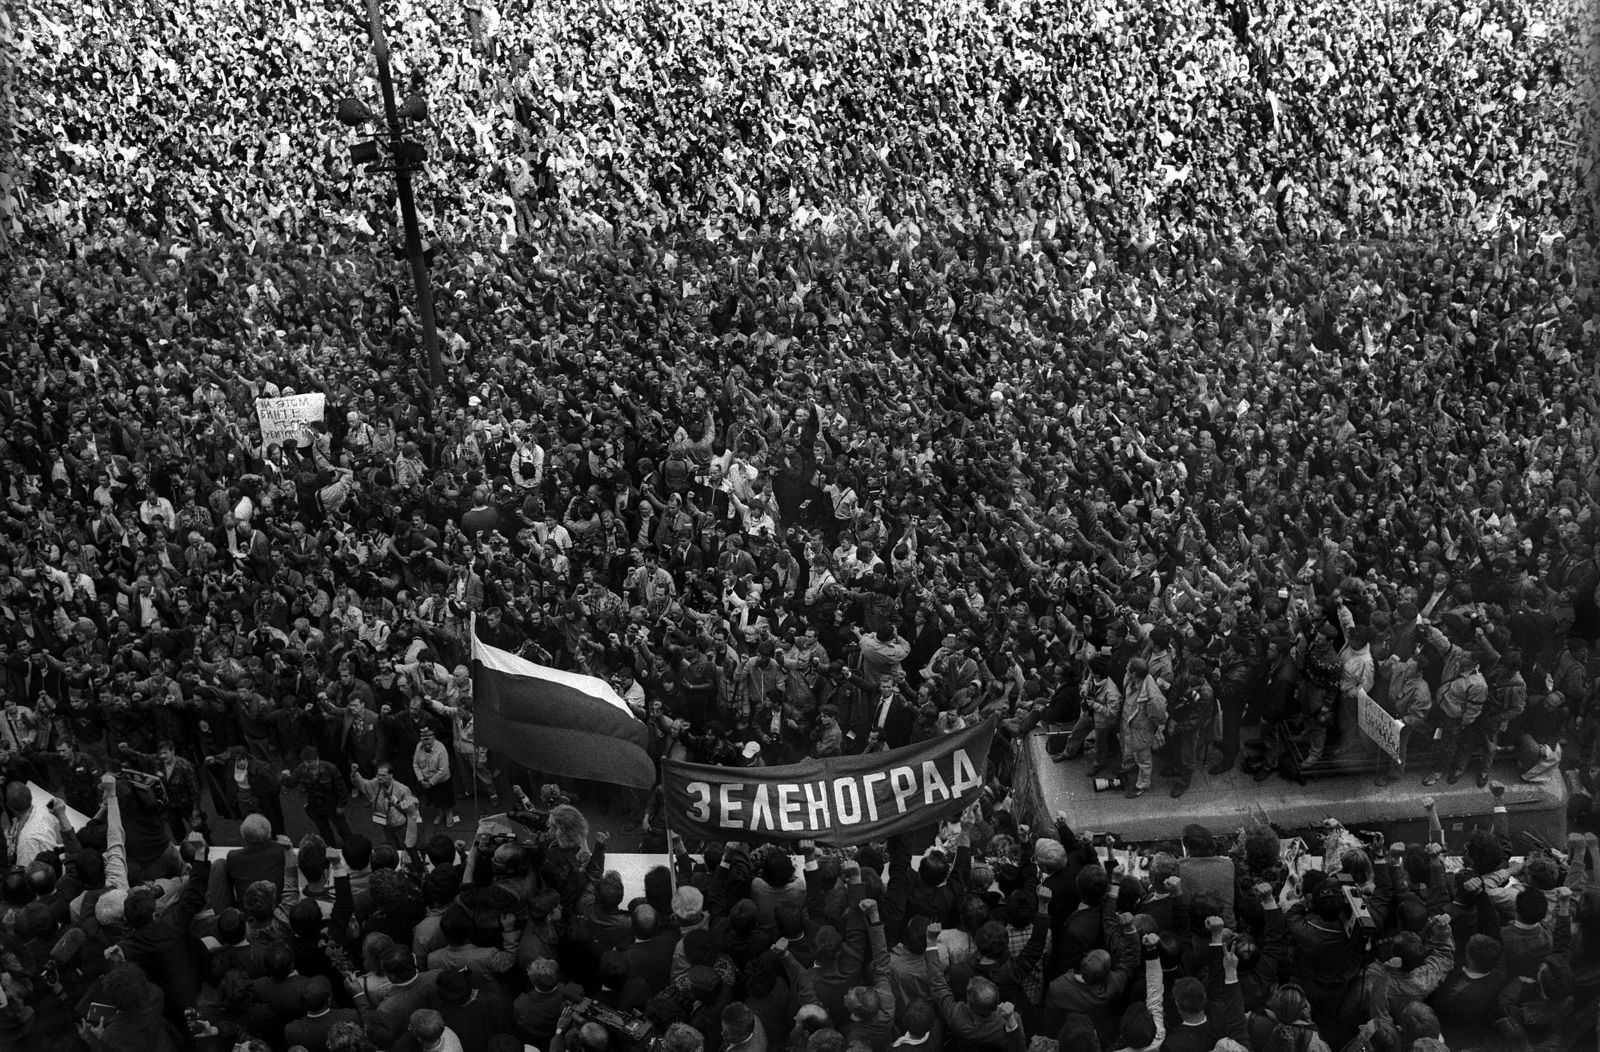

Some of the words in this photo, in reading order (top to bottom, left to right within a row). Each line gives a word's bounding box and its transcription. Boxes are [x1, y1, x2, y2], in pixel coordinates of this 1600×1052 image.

[260, 400, 274, 409] НА
[275, 397, 309, 408] ЭТОМ
[686, 748, 983, 831] ЗЕЛЕНОГРАД
